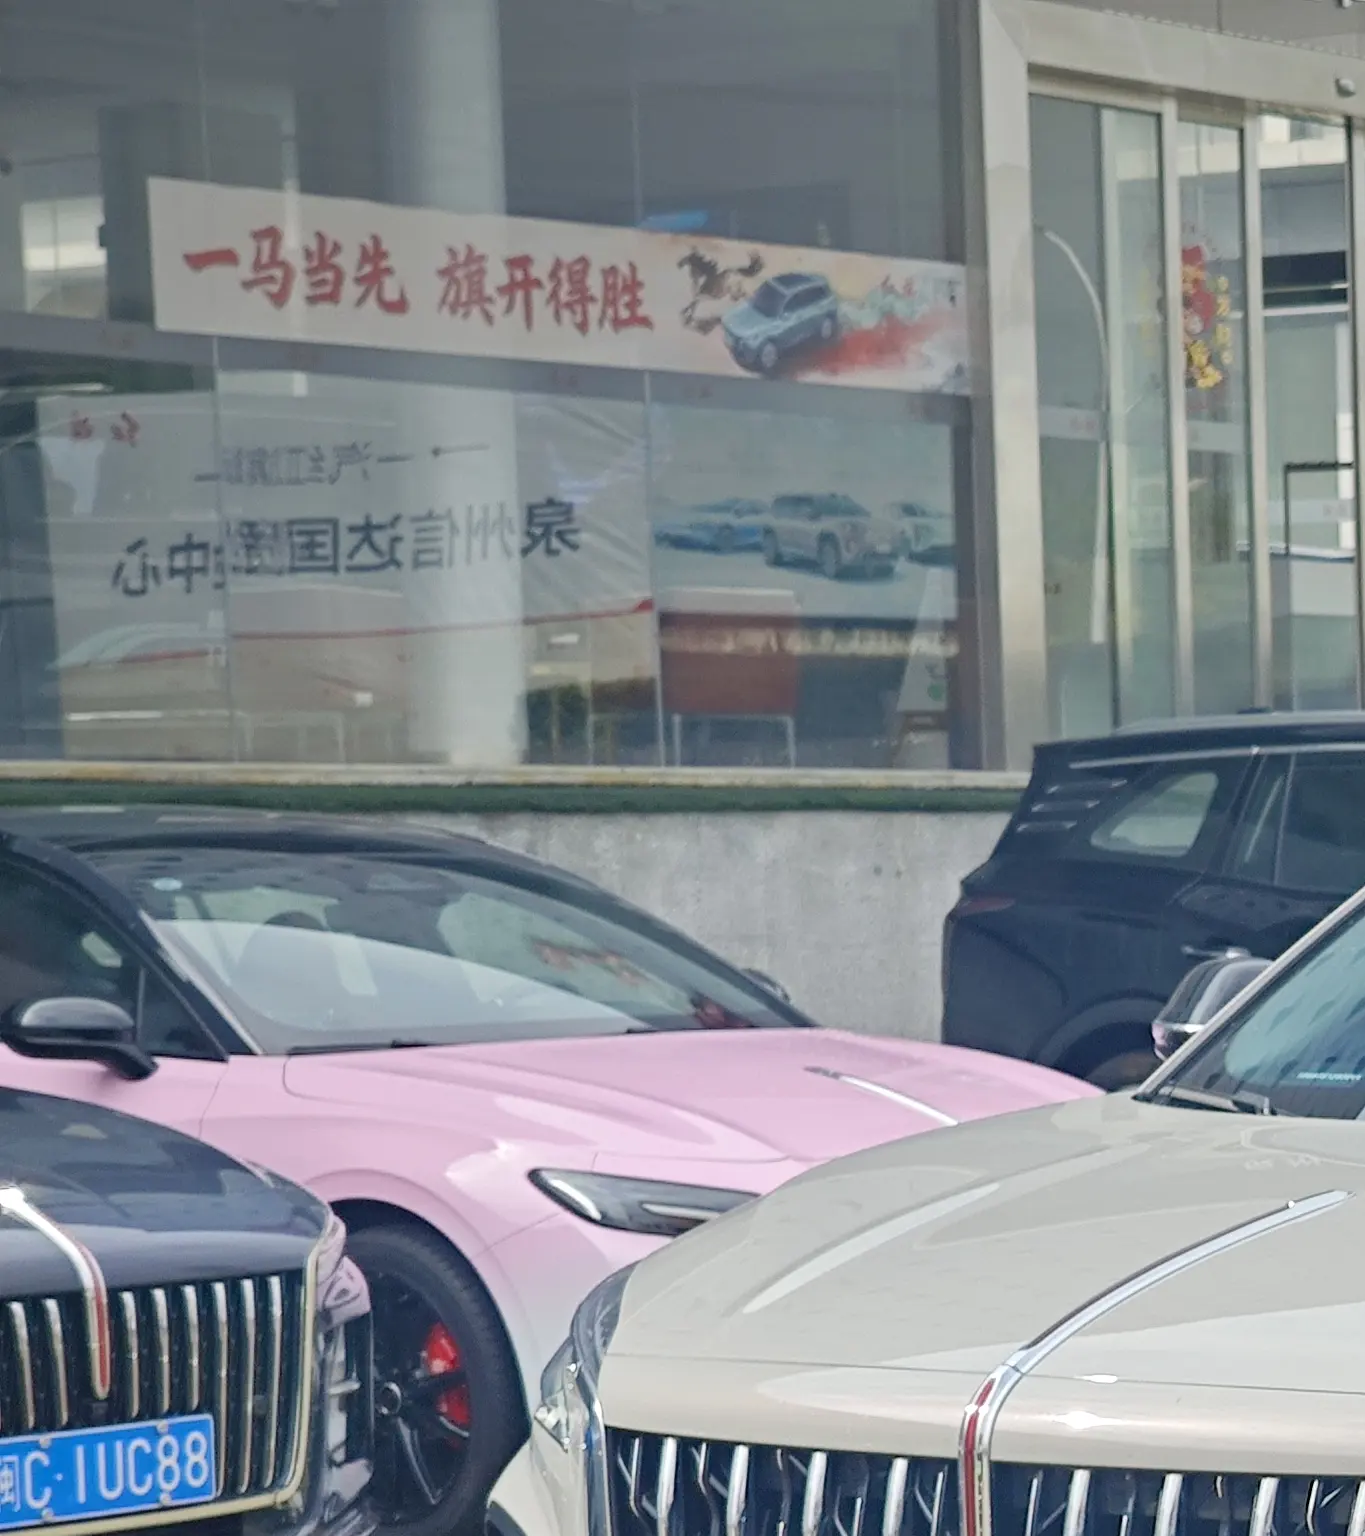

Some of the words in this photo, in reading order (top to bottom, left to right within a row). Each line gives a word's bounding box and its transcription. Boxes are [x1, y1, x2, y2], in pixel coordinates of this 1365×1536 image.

[184, 225, 409, 315] 一马当先
[437, 243, 654, 335] 旗开得胜
